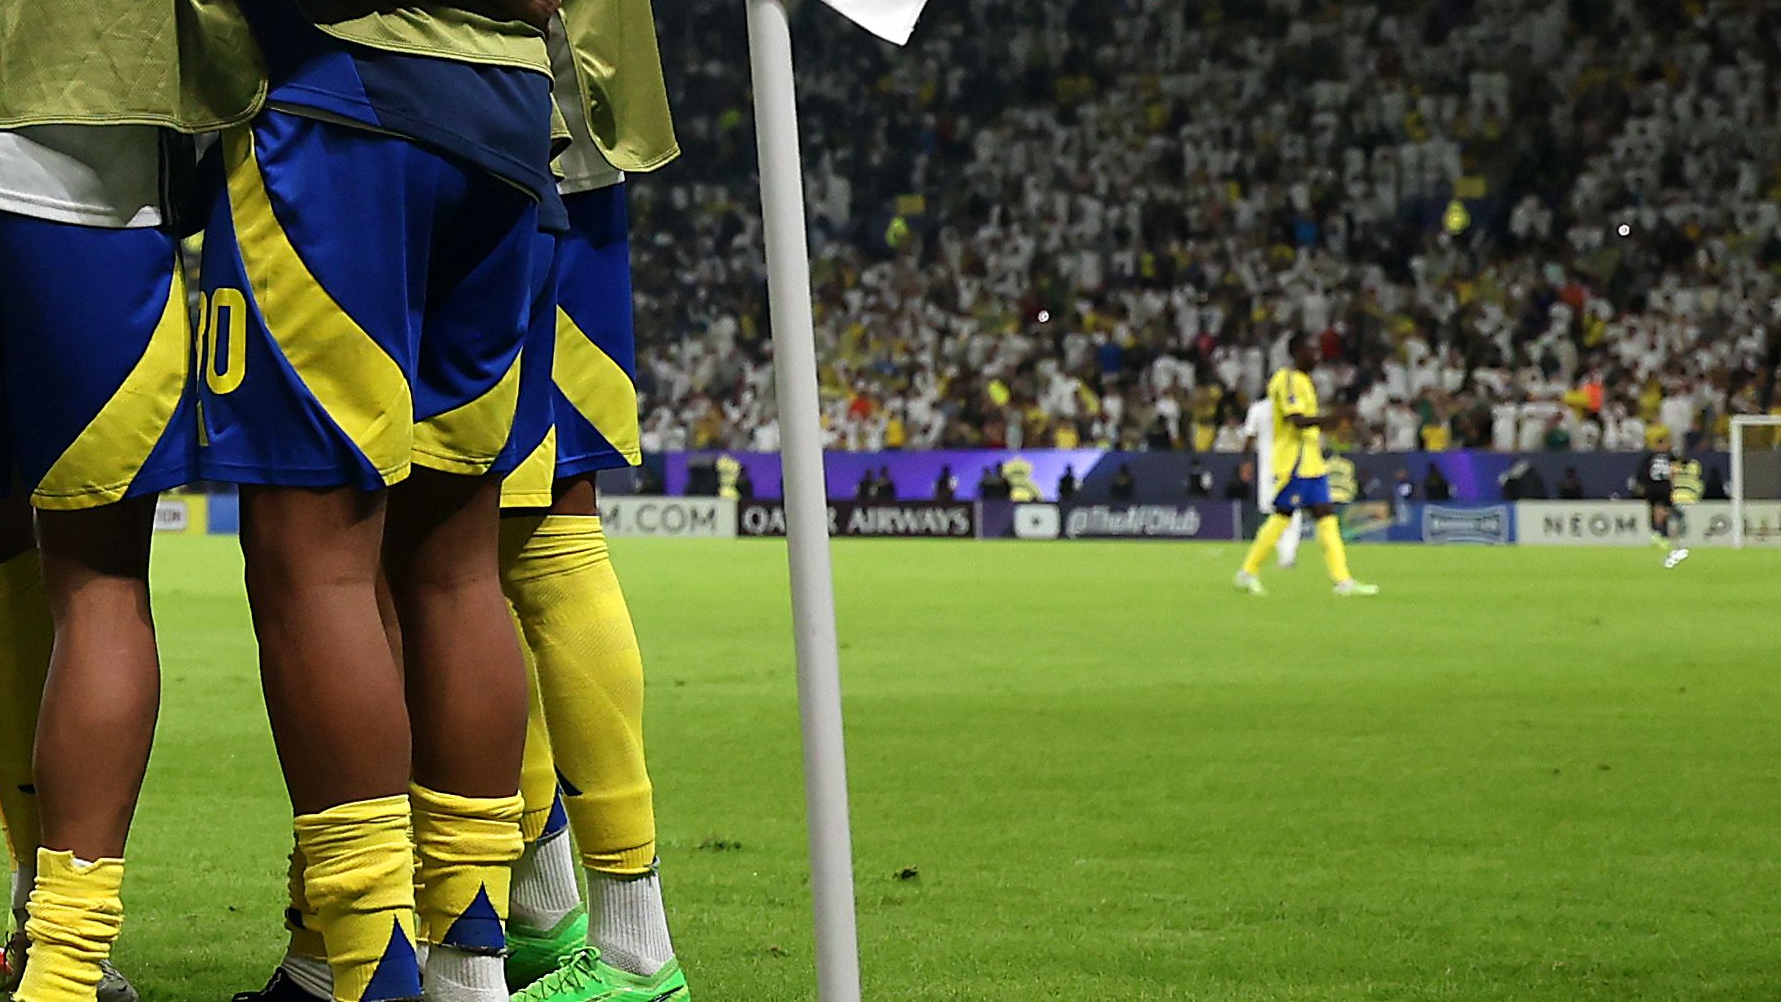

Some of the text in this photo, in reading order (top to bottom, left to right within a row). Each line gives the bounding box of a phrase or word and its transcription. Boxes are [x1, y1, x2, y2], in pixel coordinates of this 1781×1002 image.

[743, 505, 970, 535] QAR AIRWAYS
[1542, 511, 1637, 539] NEOM
